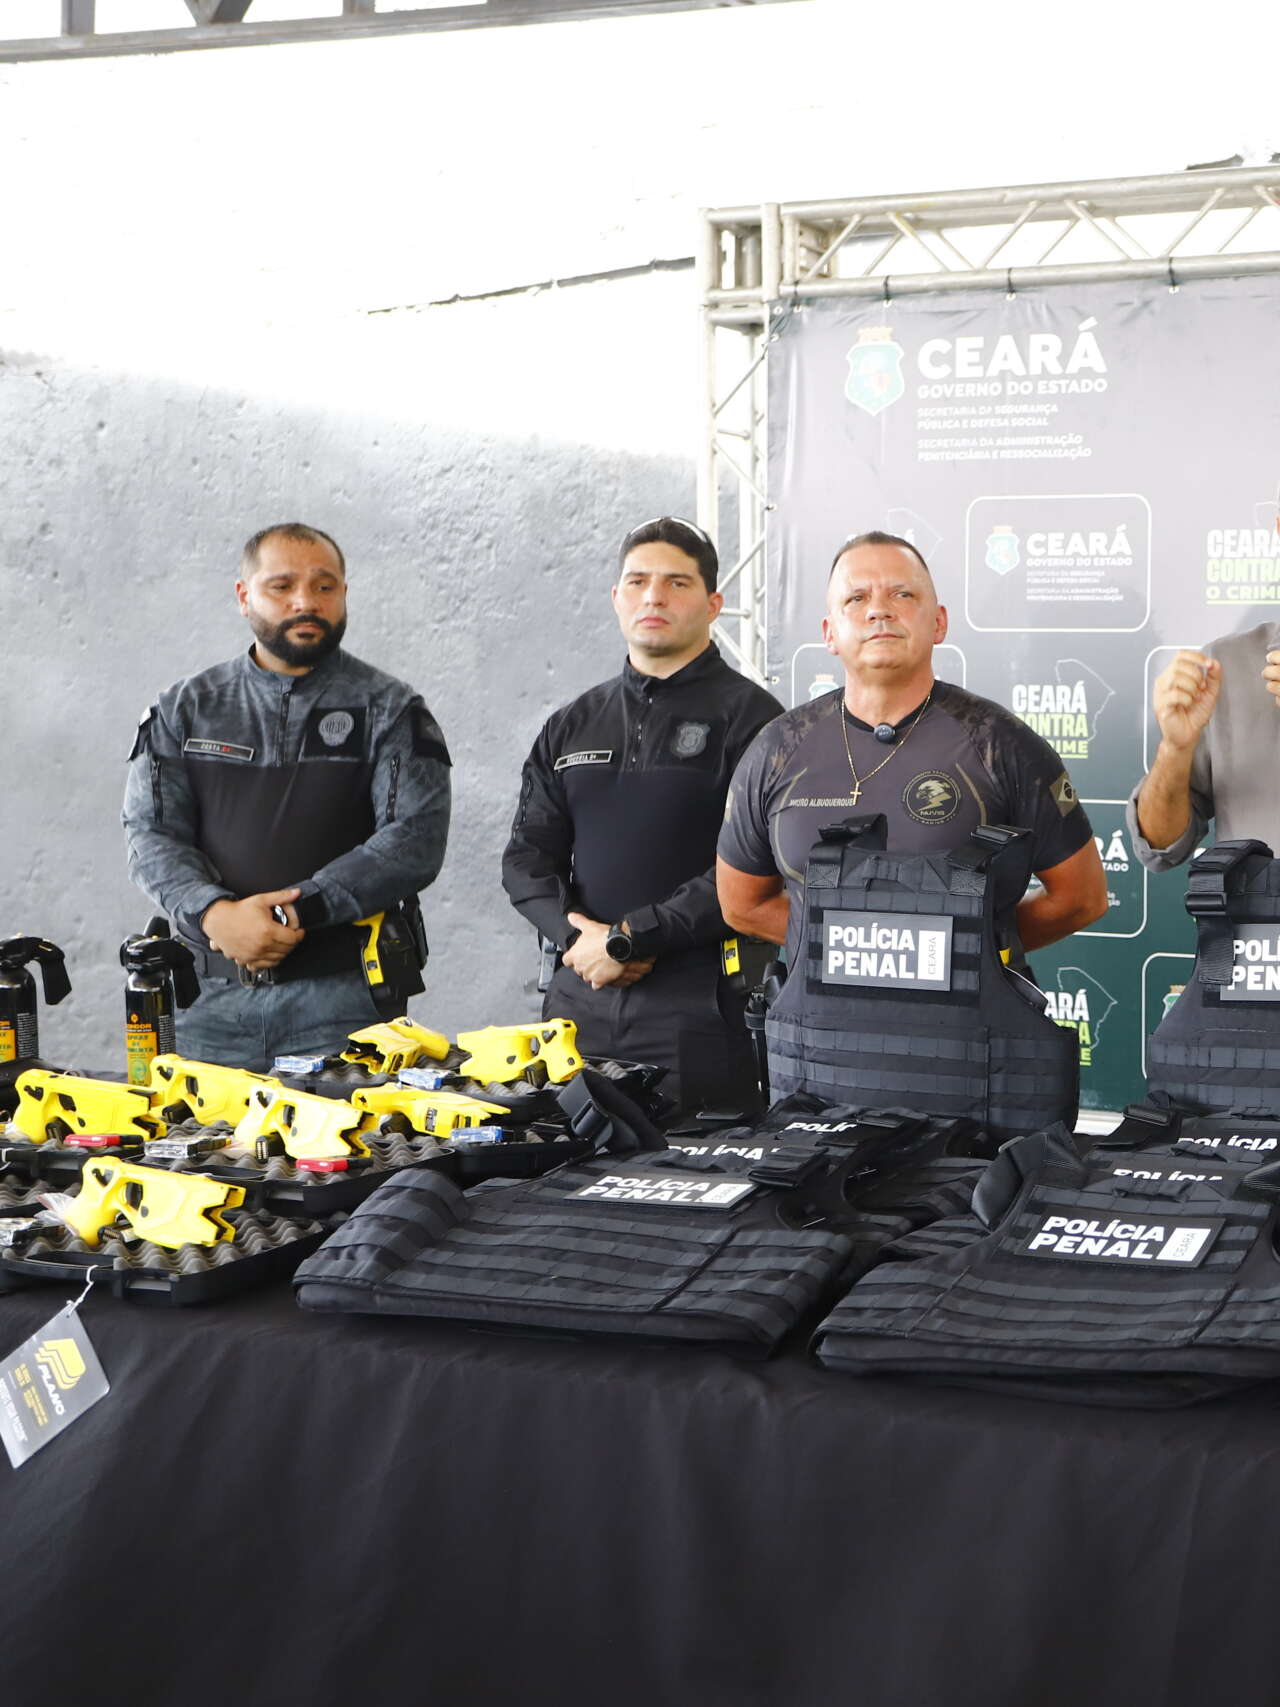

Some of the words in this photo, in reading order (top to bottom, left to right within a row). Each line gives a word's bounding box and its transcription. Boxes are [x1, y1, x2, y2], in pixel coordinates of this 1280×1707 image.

[918, 316, 1108, 380] CEARÁ
[918, 382, 1002, 399] GOVERNO
[1007, 381, 1033, 395] DO
[1038, 378, 1108, 394] ESTADO
[971, 419, 1009, 428] DEFESA
[1011, 417, 1048, 426] SOCIAL
[995, 404, 1058, 415] SEGURANÇA
[1026, 524, 1132, 556] CEARÁ
[1026, 558, 1074, 567] GOVERNO
[1076, 558, 1091, 566] DO
[1093, 558, 1132, 566] ESTADO
[1206, 586, 1220, 599] O
[1012, 680, 1087, 713] CEARÁ
[829, 923, 915, 951] POLÍCIA
[828, 951, 914, 979] PENAL
[1044, 988, 1089, 1021] ARÁ
[579, 1186, 693, 1203] PENAL
[597, 1175, 710, 1191] POLÍCIA
[1042, 1216, 1166, 1242] POLÍCIA
[1028, 1232, 1153, 1259] PENAL
[37, 1364, 65, 1415] PLANO
